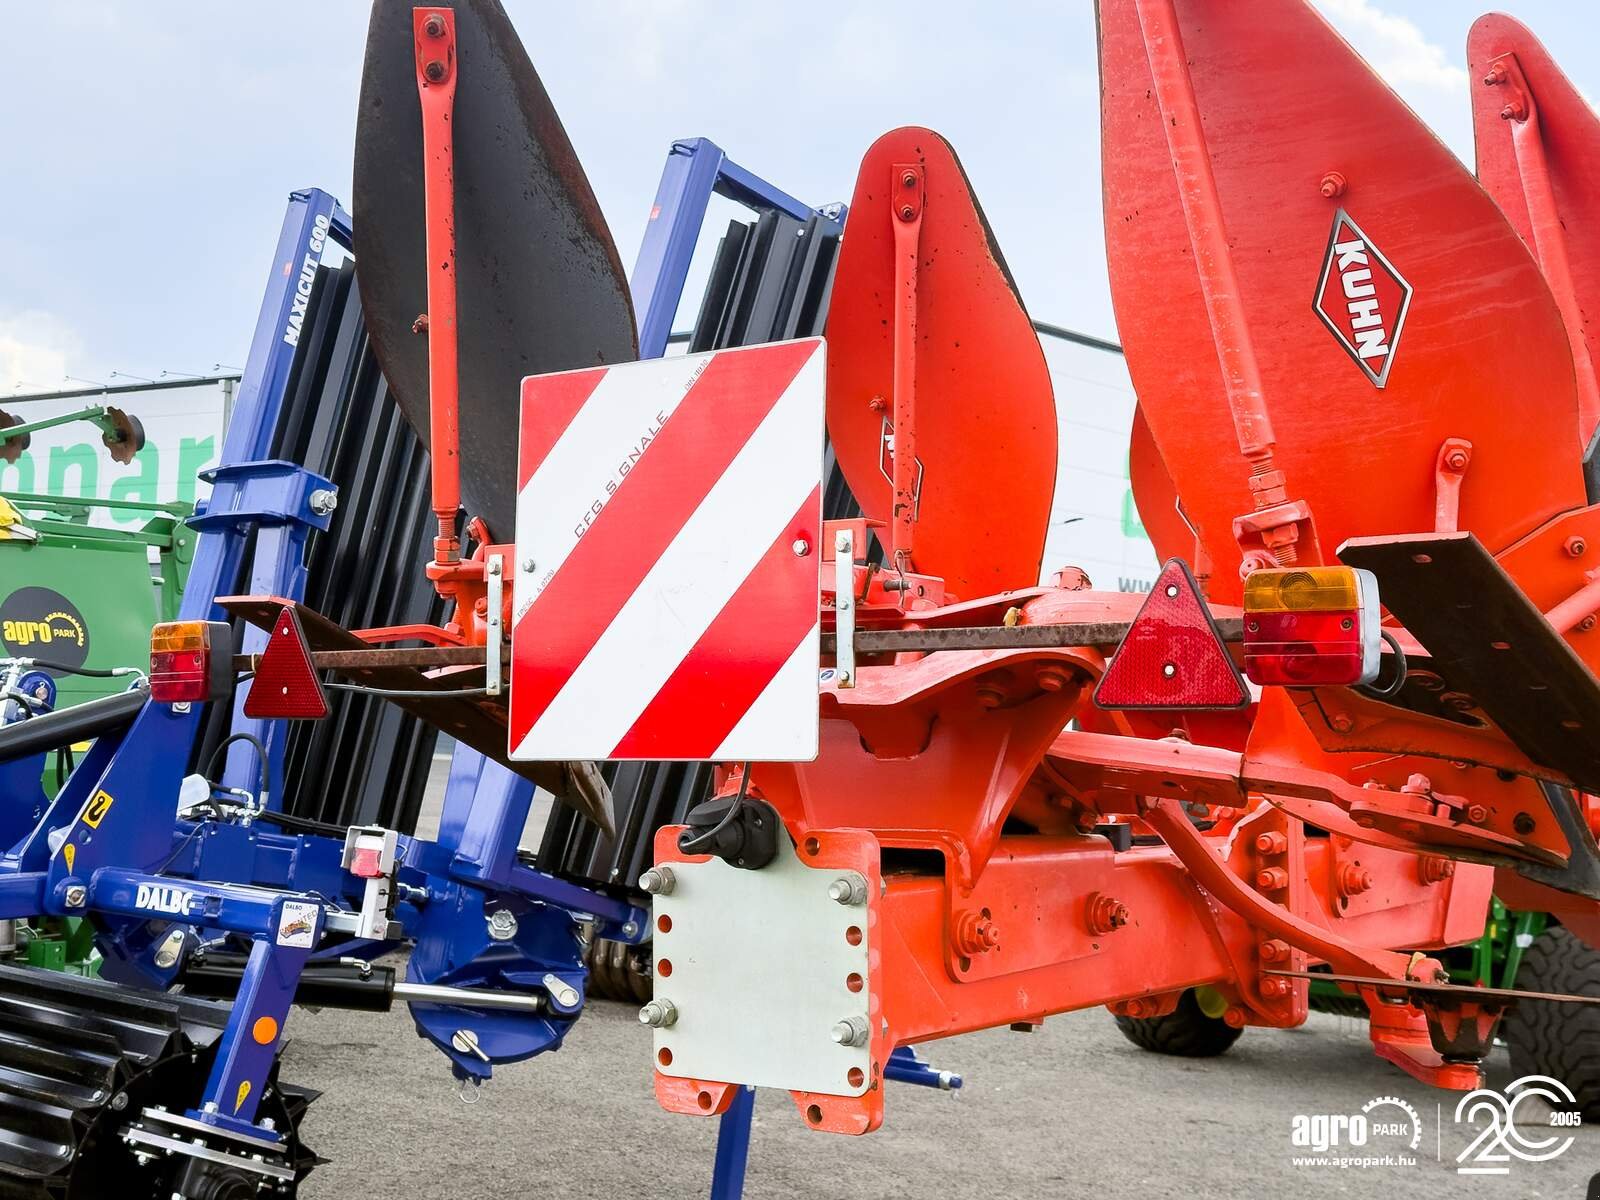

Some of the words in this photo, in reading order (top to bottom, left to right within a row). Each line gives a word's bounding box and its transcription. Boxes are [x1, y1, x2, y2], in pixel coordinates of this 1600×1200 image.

[284, 253, 319, 347] MAXICUT
[309, 214, 329, 253] 600
[1334, 239, 1389, 359] KUHN
[574, 499, 603, 538] CFG
[605, 410, 668, 495] SGNALE
[3, 620, 52, 645] agro
[54, 628, 76, 638] PARK
